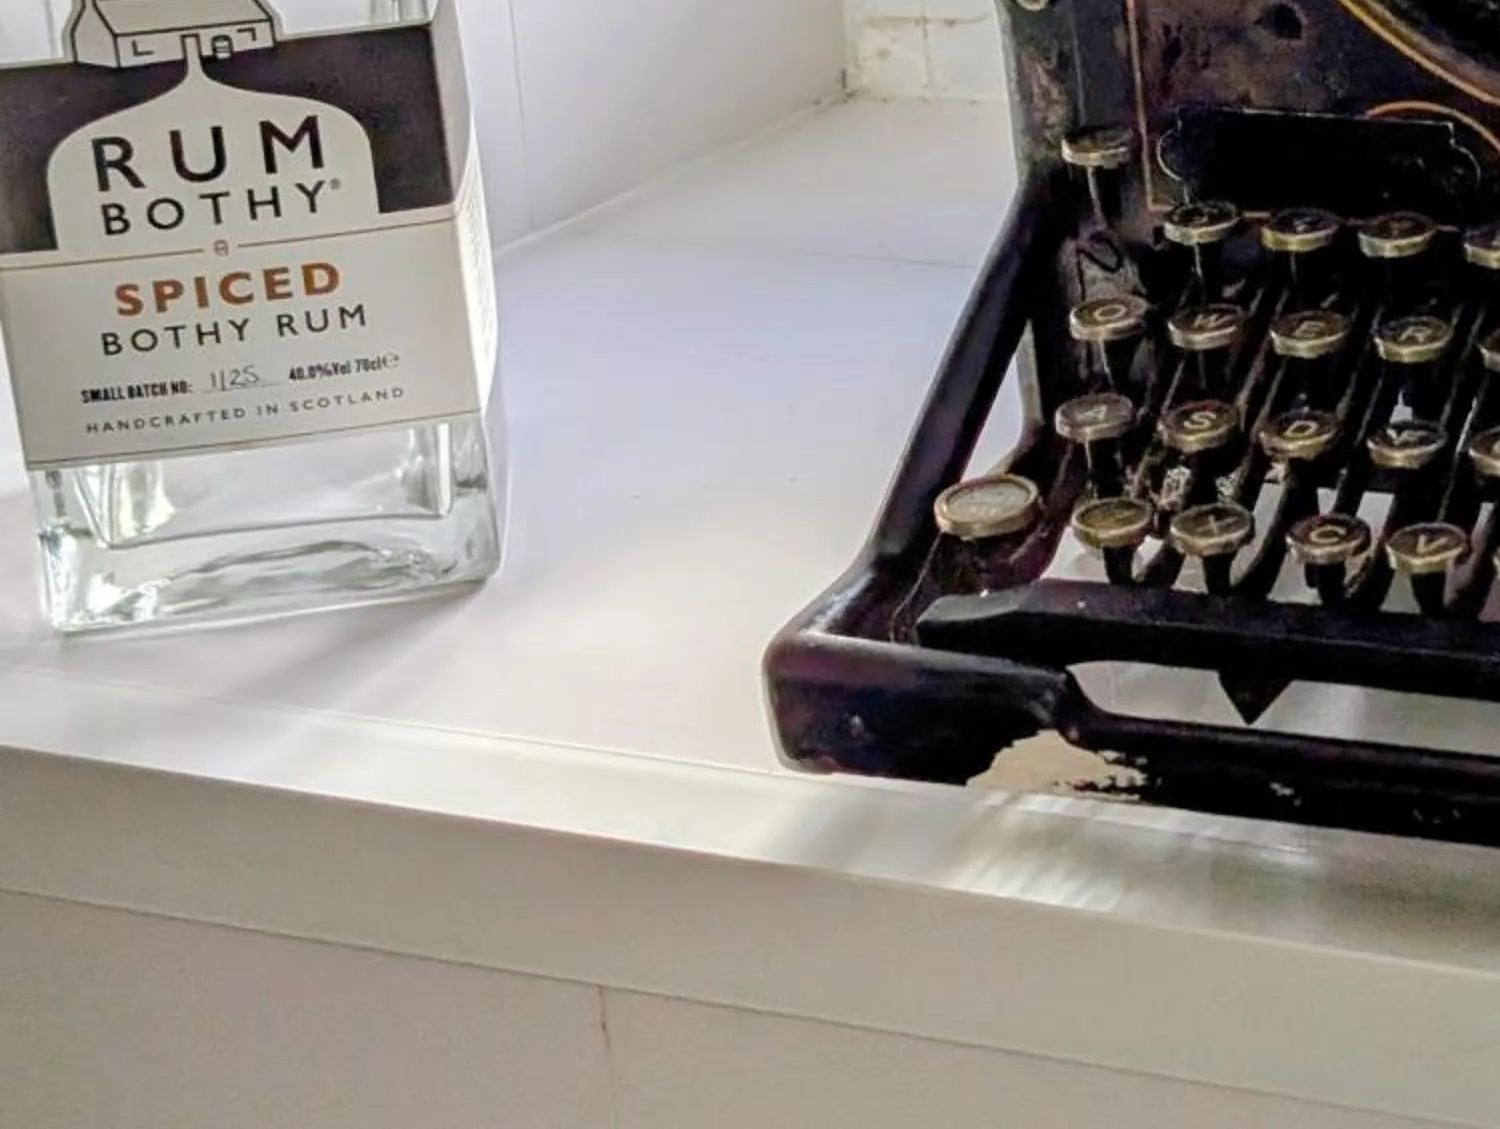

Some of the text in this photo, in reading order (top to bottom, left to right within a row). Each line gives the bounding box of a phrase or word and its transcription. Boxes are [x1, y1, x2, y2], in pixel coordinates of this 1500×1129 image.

[92, 115, 324, 192] RUM
[115, 262, 341, 317] SPICED
[101, 304, 366, 356] BOTHY RUM
[80, 386, 125, 404] SMALL
[128, 382, 168, 399] BATCH
[86, 387, 404, 433] HANDCRAFTED IN SCOTLAND
[1183, 411, 1217, 429] S
[1309, 525, 1346, 544] C
[1416, 533, 1448, 554] V
